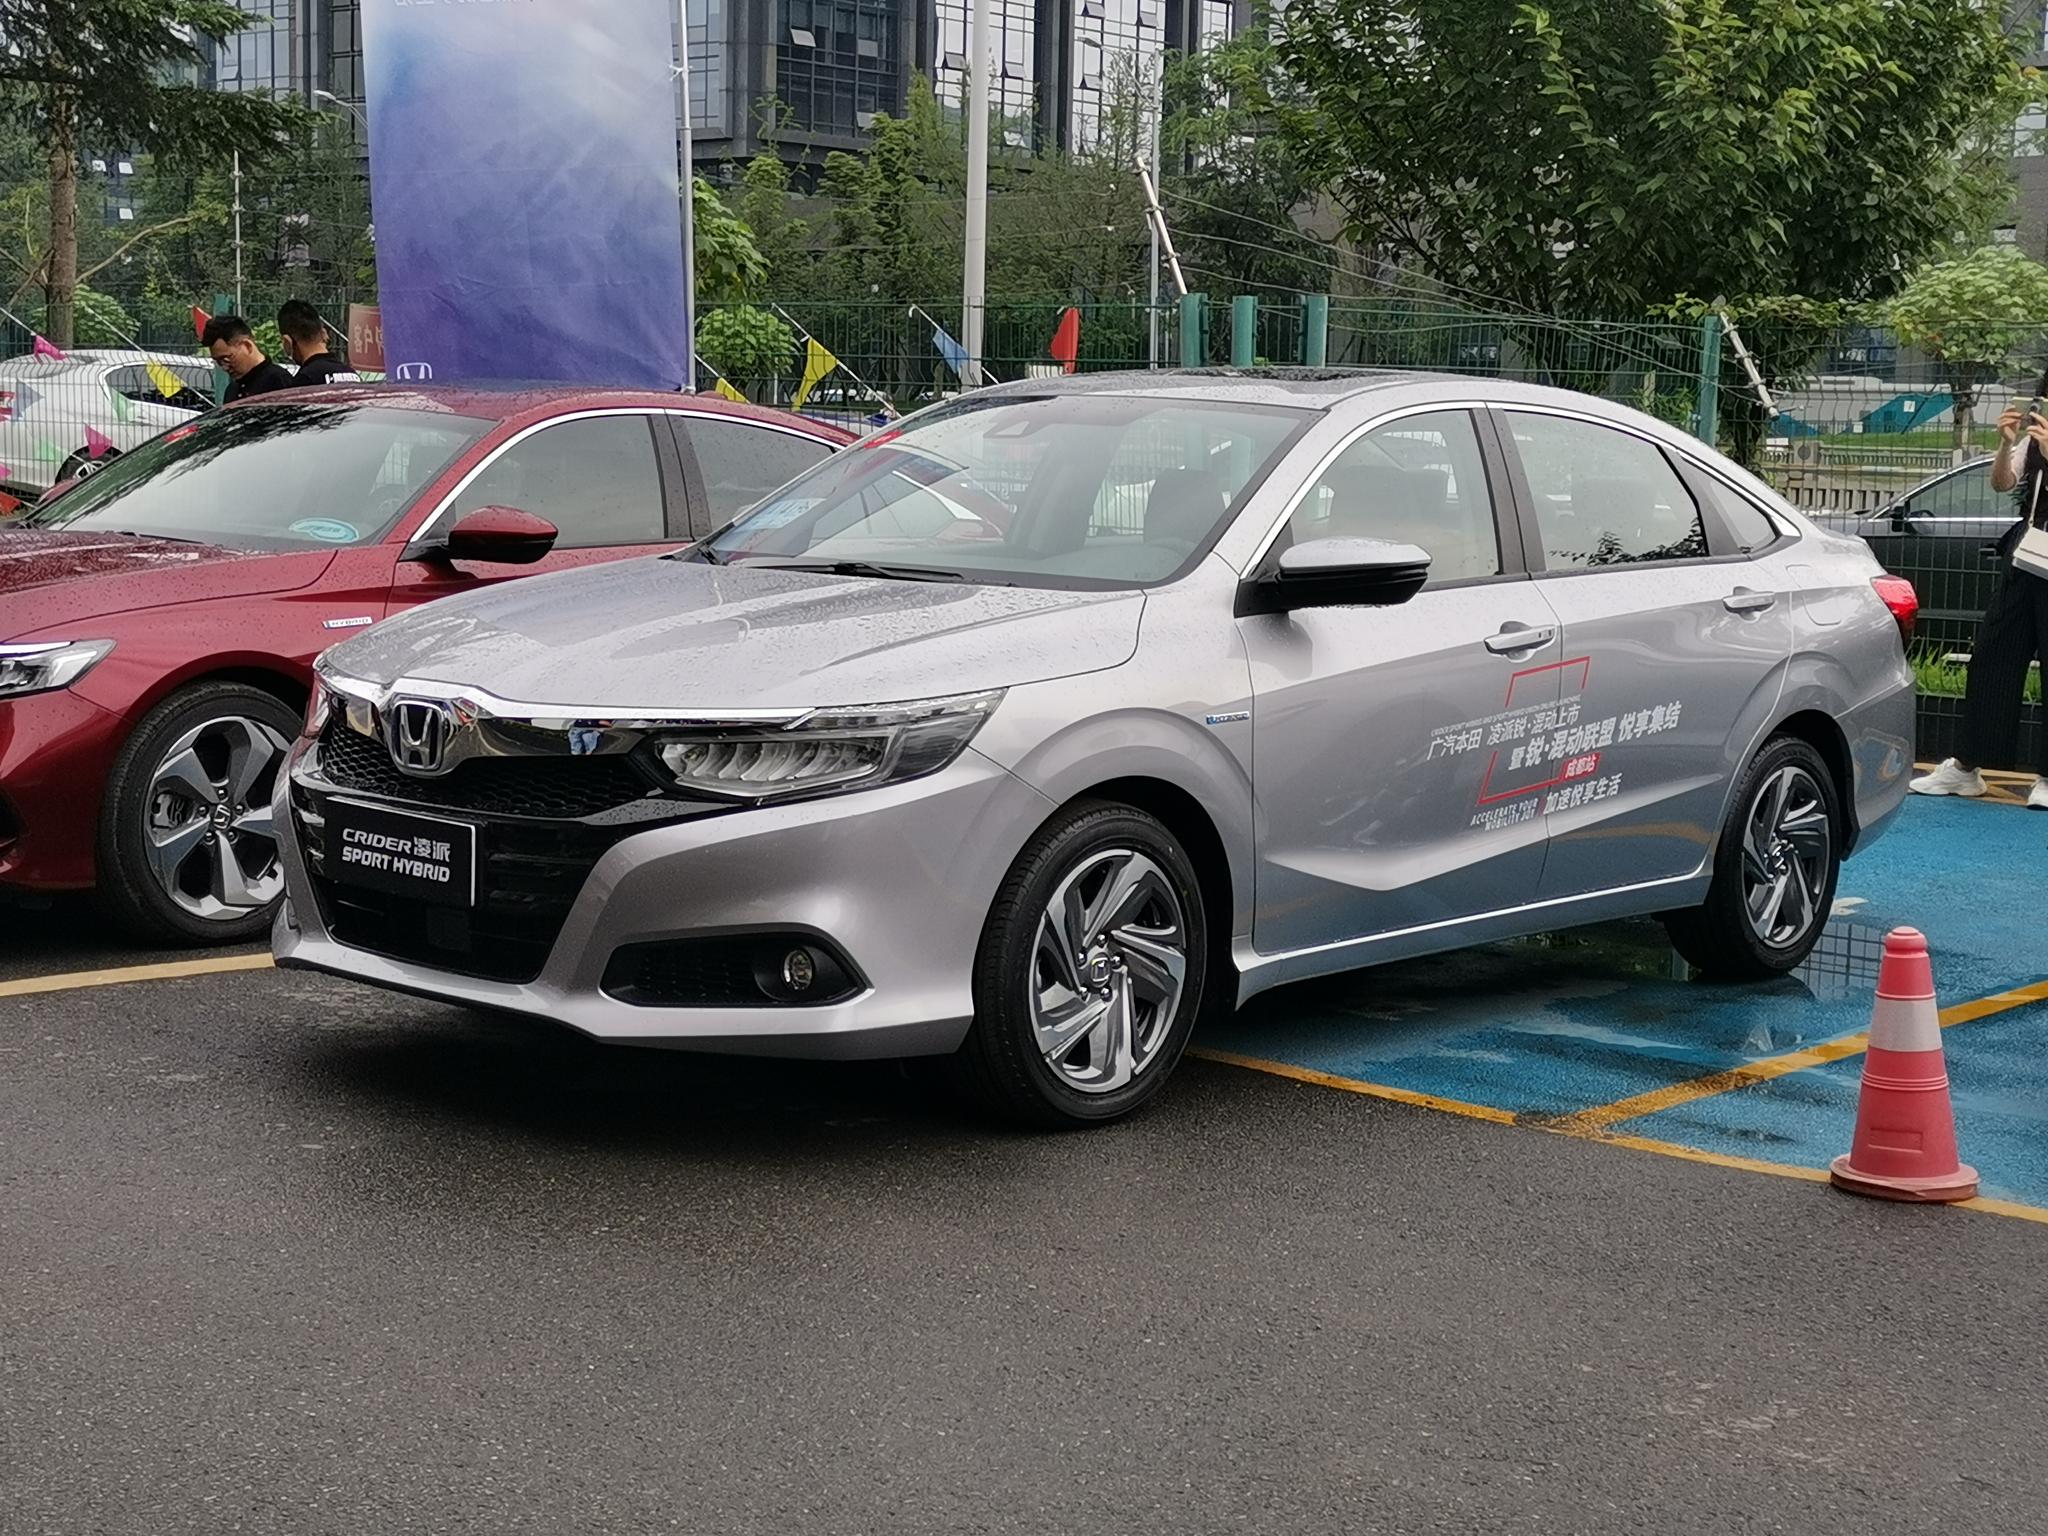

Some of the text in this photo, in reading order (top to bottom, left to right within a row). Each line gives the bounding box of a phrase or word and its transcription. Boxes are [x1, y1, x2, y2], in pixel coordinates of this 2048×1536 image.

[1618, 700, 1682, 743] 悦享集结
[1427, 727, 1483, 760] 广汽本田
[1564, 756, 1597, 779] 成都站
[1543, 773, 1622, 815] 加速悦享生活
[1470, 797, 1539, 826] ACCELERATE YOUR
[1485, 808, 1536, 831] MOBILITY JOY
[342, 828, 451, 862] CRIDER 凌派
[342, 846, 451, 882] SPORT HYBRID
